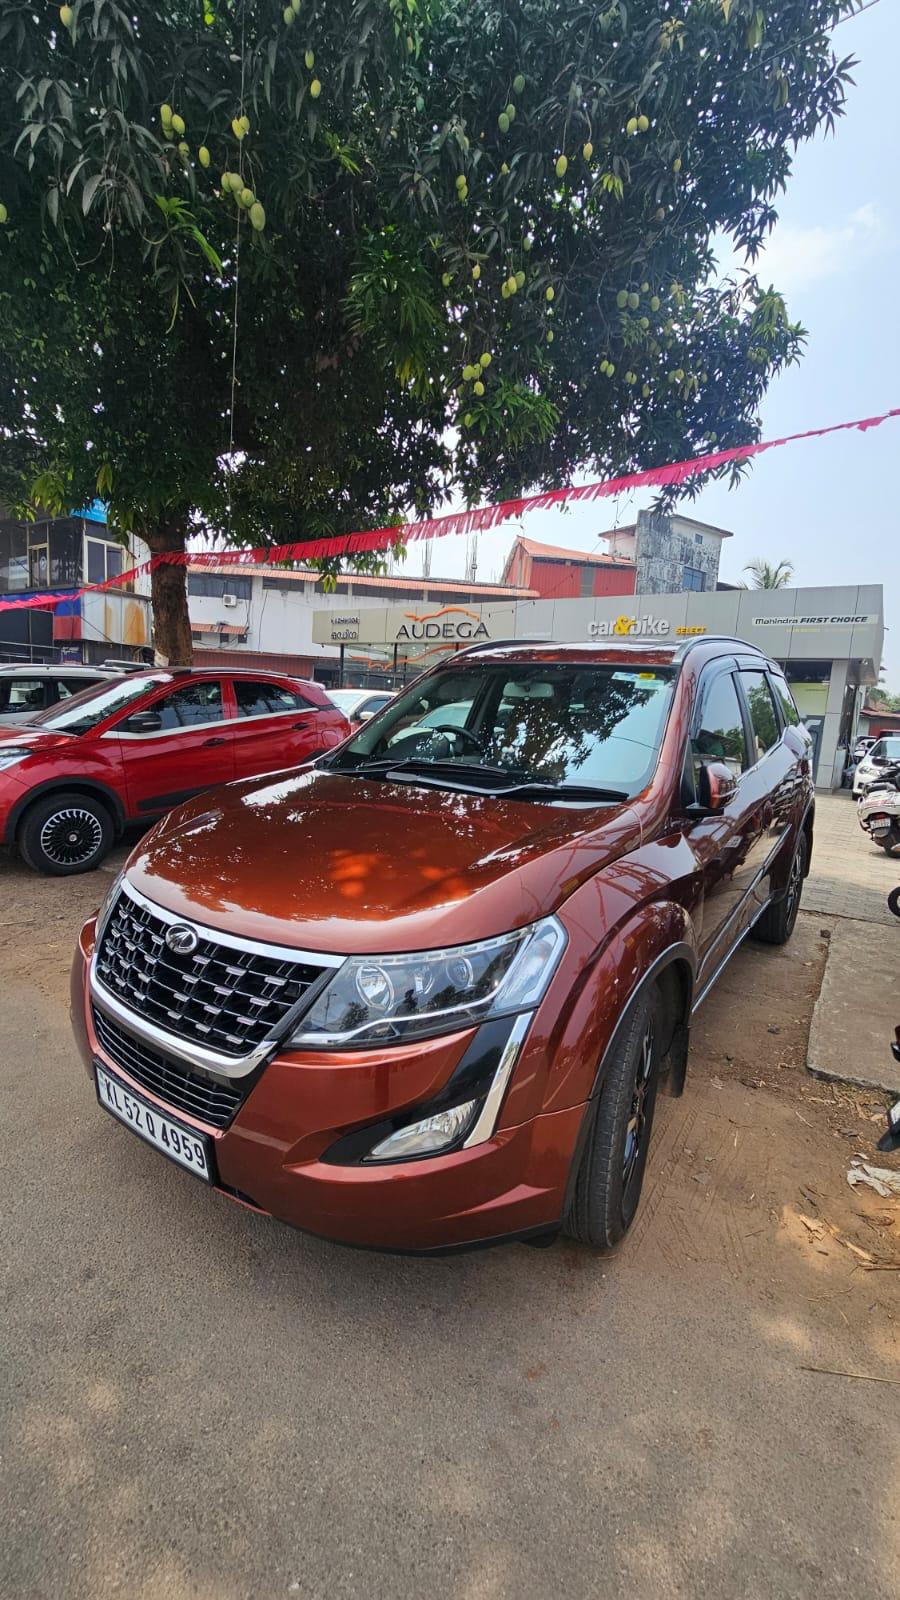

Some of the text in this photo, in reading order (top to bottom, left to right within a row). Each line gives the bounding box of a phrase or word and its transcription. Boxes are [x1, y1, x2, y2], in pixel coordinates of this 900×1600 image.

[588, 615, 706, 636] car&bike SELECT
[799, 616, 829, 624] FIRST
[396, 622, 490, 639] AUDEGA
[161, 1122, 206, 1170] 4959
